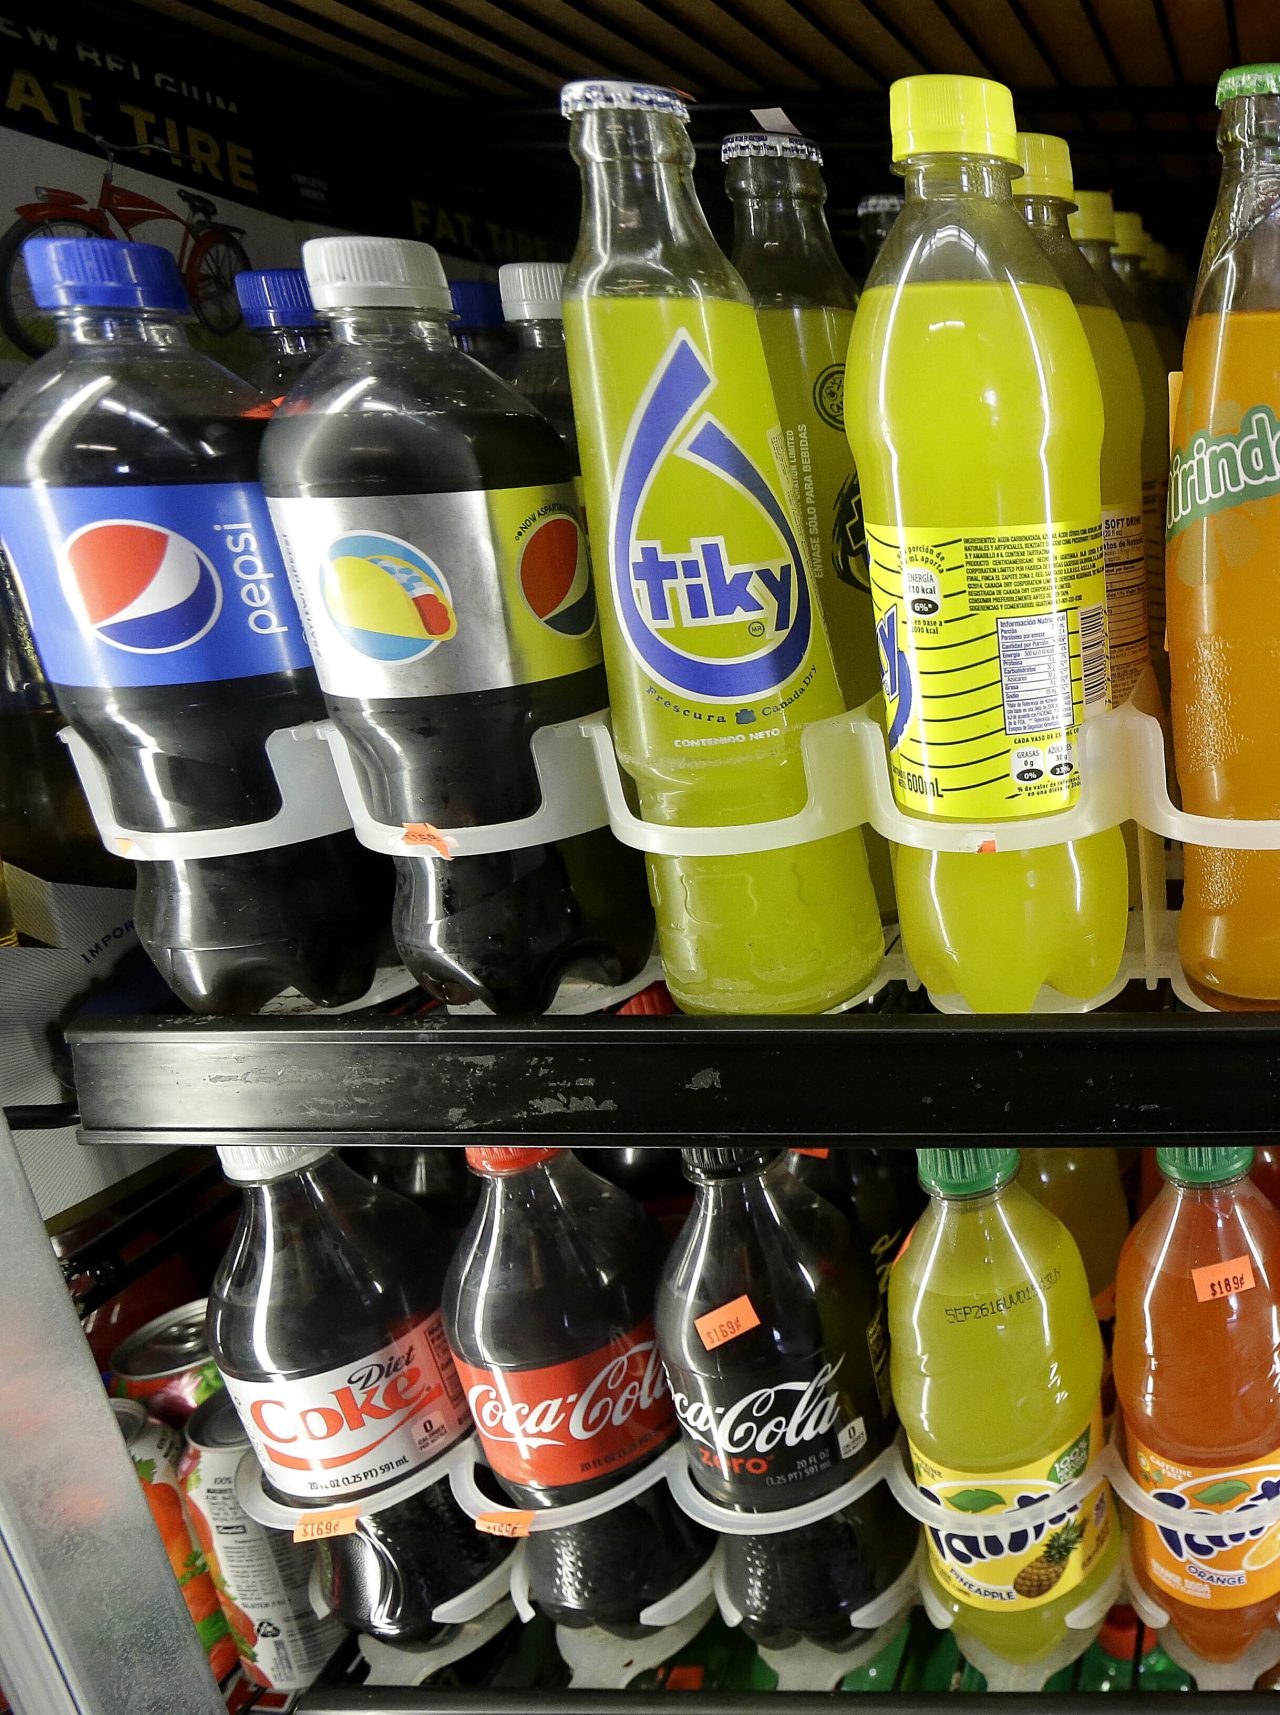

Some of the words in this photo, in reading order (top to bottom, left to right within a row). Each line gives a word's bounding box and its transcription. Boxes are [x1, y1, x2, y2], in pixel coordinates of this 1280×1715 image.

[119, 101, 258, 193] TIRE
[798, 424, 811, 472] BEBIDAS
[803, 475, 815, 505] PARA
[520, 513, 537, 533] NOW
[1105, 517, 1125, 529] SOFT
[811, 537, 823, 578] ENVASE
[907, 545, 934, 555] porción
[935, 552, 945, 562] de
[920, 556, 944, 574] aporta
[214, 521, 289, 635] pepsi
[631, 541, 792, 633] tiky
[907, 572, 934, 583] ENERGÍA
[921, 585, 936, 594] kcal
[925, 627, 938, 635] kcal
[647, 687, 726, 722] Frescura
[762, 687, 805, 717] Canada
[803, 665, 817, 687] Dry
[750, 728, 780, 741] NETO
[1017, 750, 1039, 759] GRASAS
[348, 1346, 416, 1391] Diet
[250, 1366, 424, 1443] Coke
[423, 1420, 433, 1433] 0
[330, 1478, 340, 1488] OZ
[342, 1473, 362, 1487] (1.25
[363, 1467, 378, 1480] PT)
[379, 1461, 395, 1474] 591
[395, 1455, 409, 1467] mL
[804, 1465, 819, 1477] 591
[950, 1568, 1015, 1600] PINEAPPLE
[1188, 1565, 1245, 1585] ORANGE
